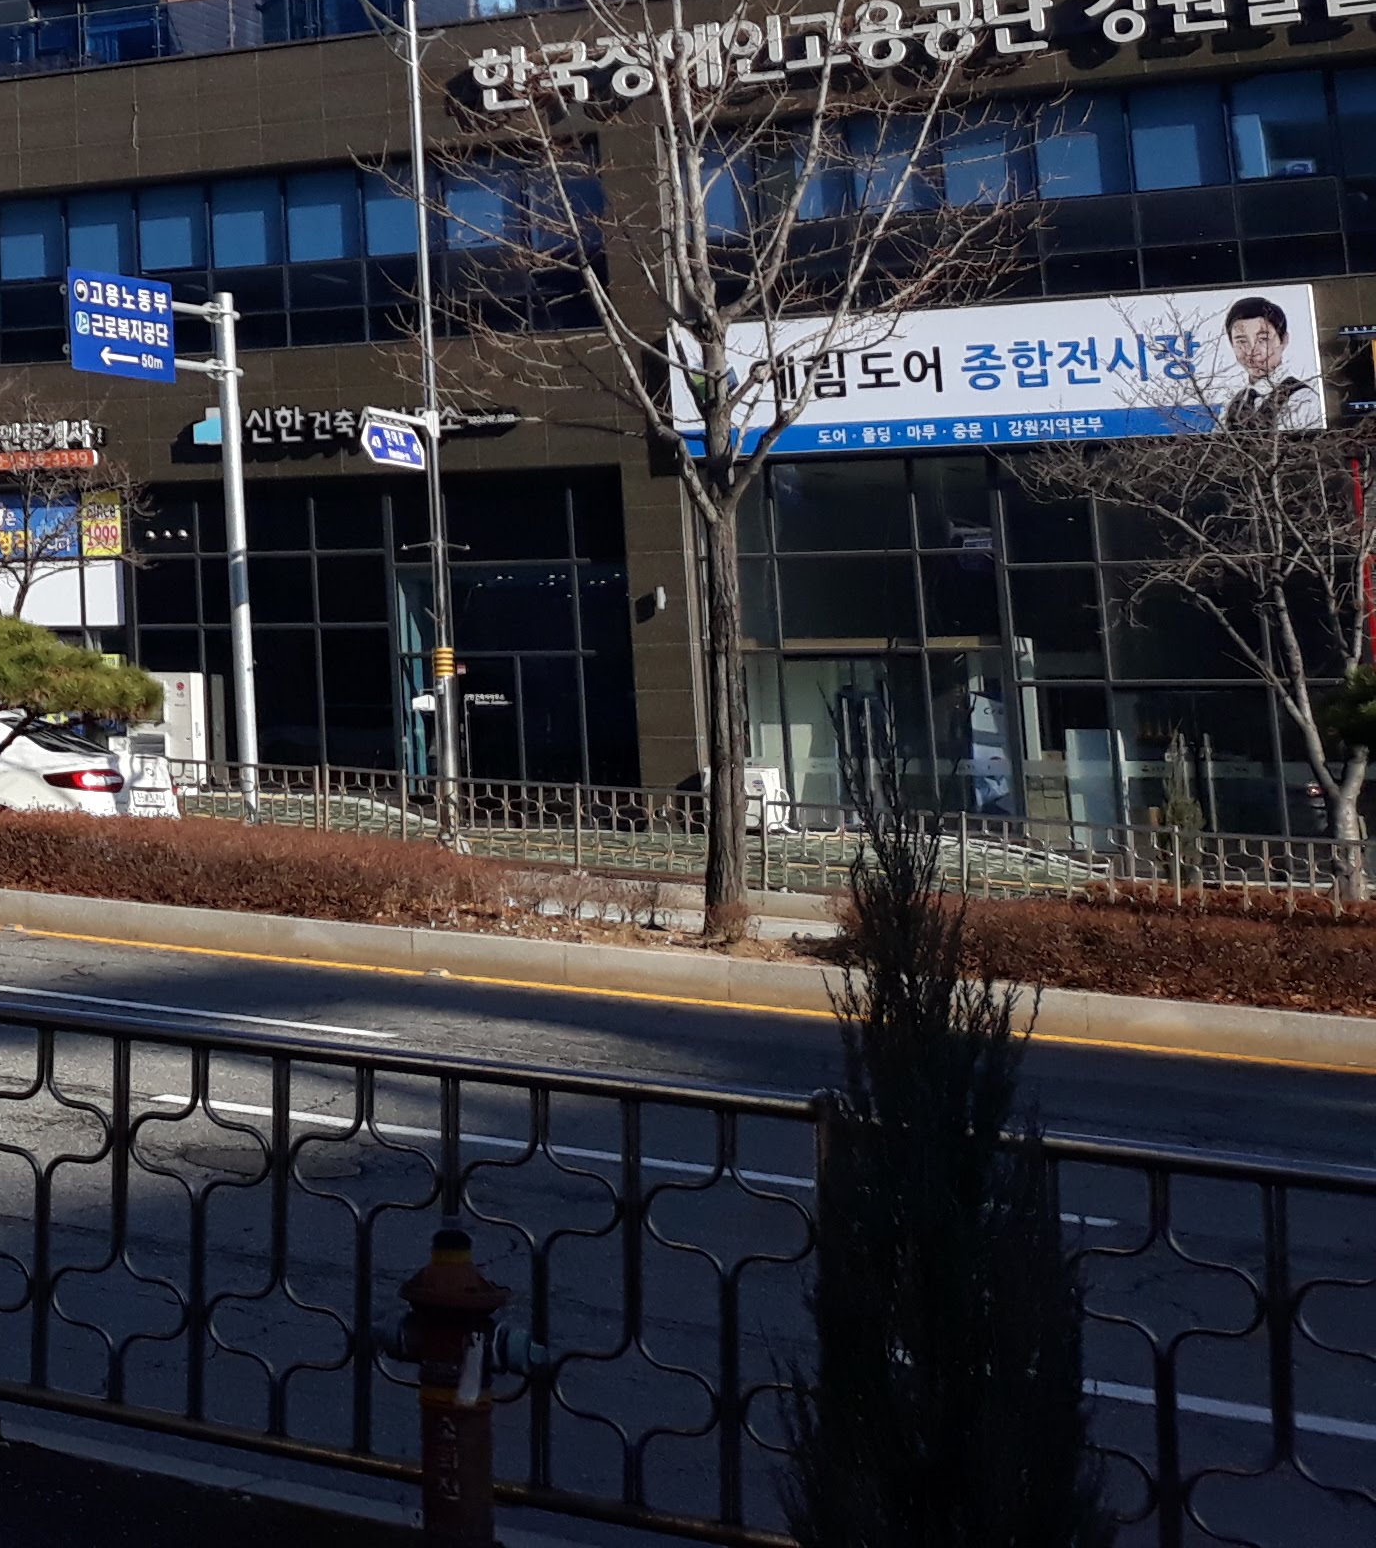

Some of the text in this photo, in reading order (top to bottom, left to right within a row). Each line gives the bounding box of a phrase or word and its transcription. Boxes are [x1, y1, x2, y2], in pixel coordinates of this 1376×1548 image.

[89, 280, 168, 315] 고용노동부
[91, 312, 170, 348] 근로복지공단
[141, 352, 164, 370] 50m
[960, 330, 1201, 390] 종합전시장
[245, 405, 305, 444] 신한
[817, 427, 848, 446] 도어
[905, 424, 937, 443] 마루
[952, 422, 984, 441] 중문
[1007, 414, 1106, 438] 강원지역본부
